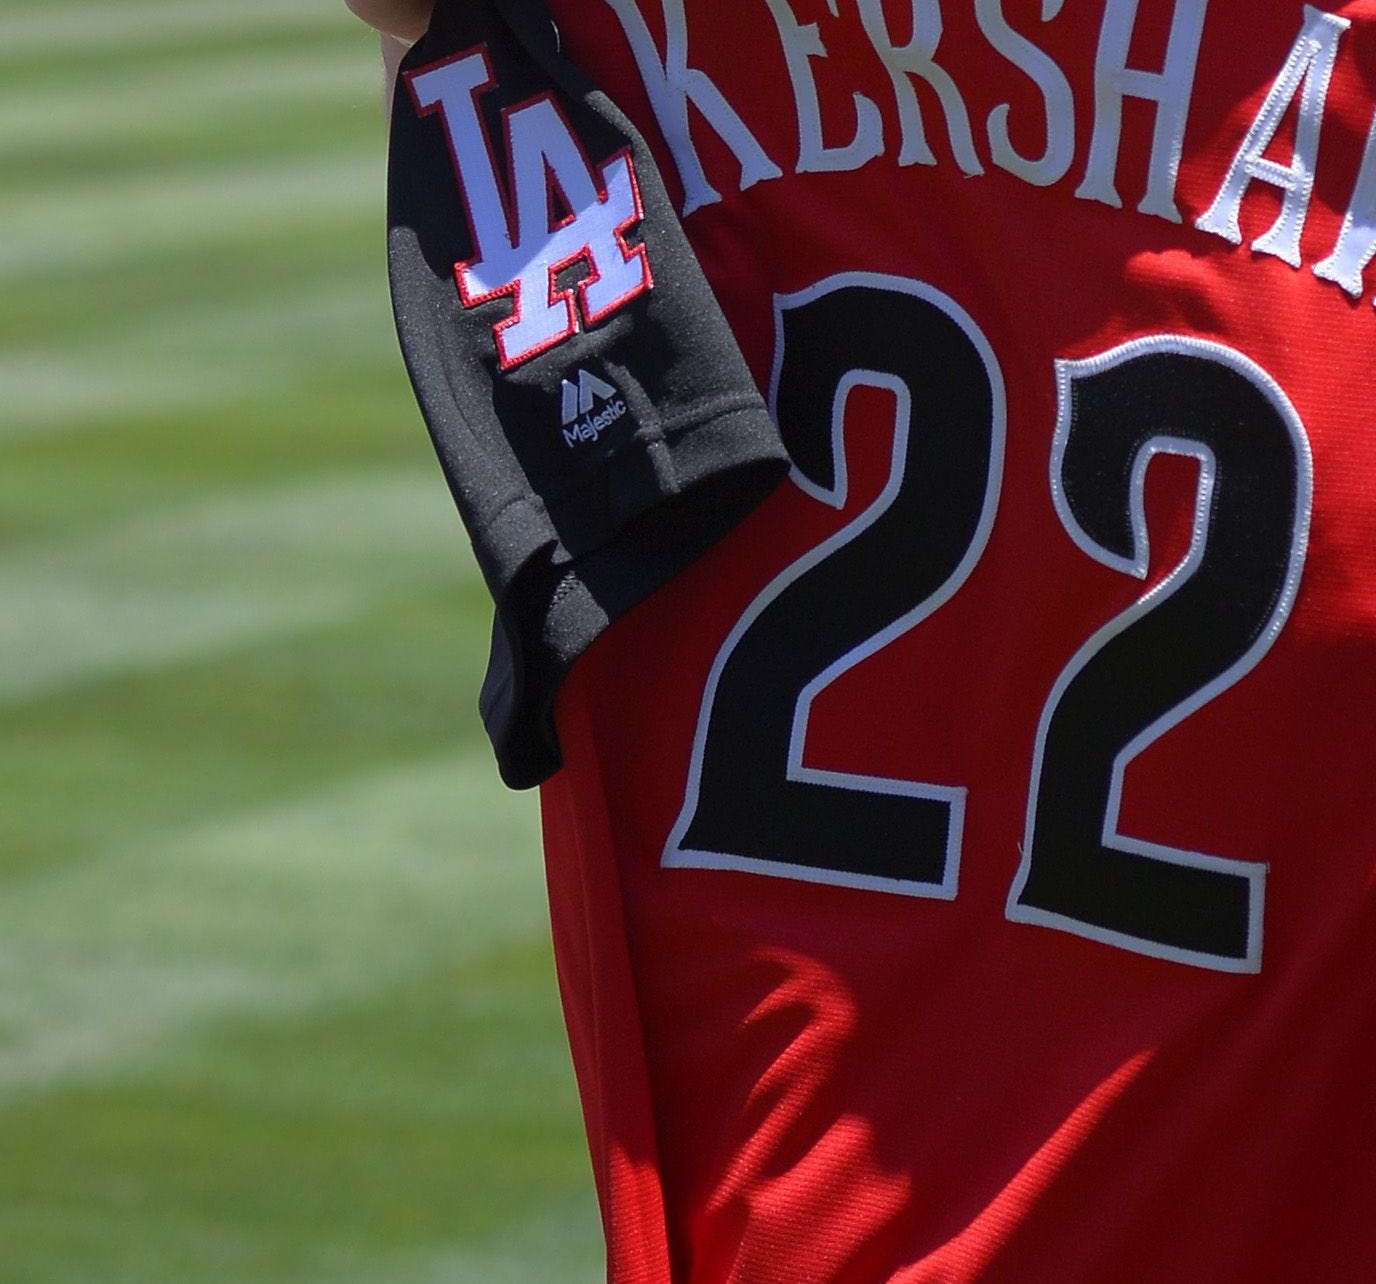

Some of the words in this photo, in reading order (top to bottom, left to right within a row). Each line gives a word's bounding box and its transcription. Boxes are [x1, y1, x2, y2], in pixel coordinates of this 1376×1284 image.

[403, 42, 654, 370] LA
[562, 399, 627, 449] Majestic
[660, 271, 1314, 975] 22
